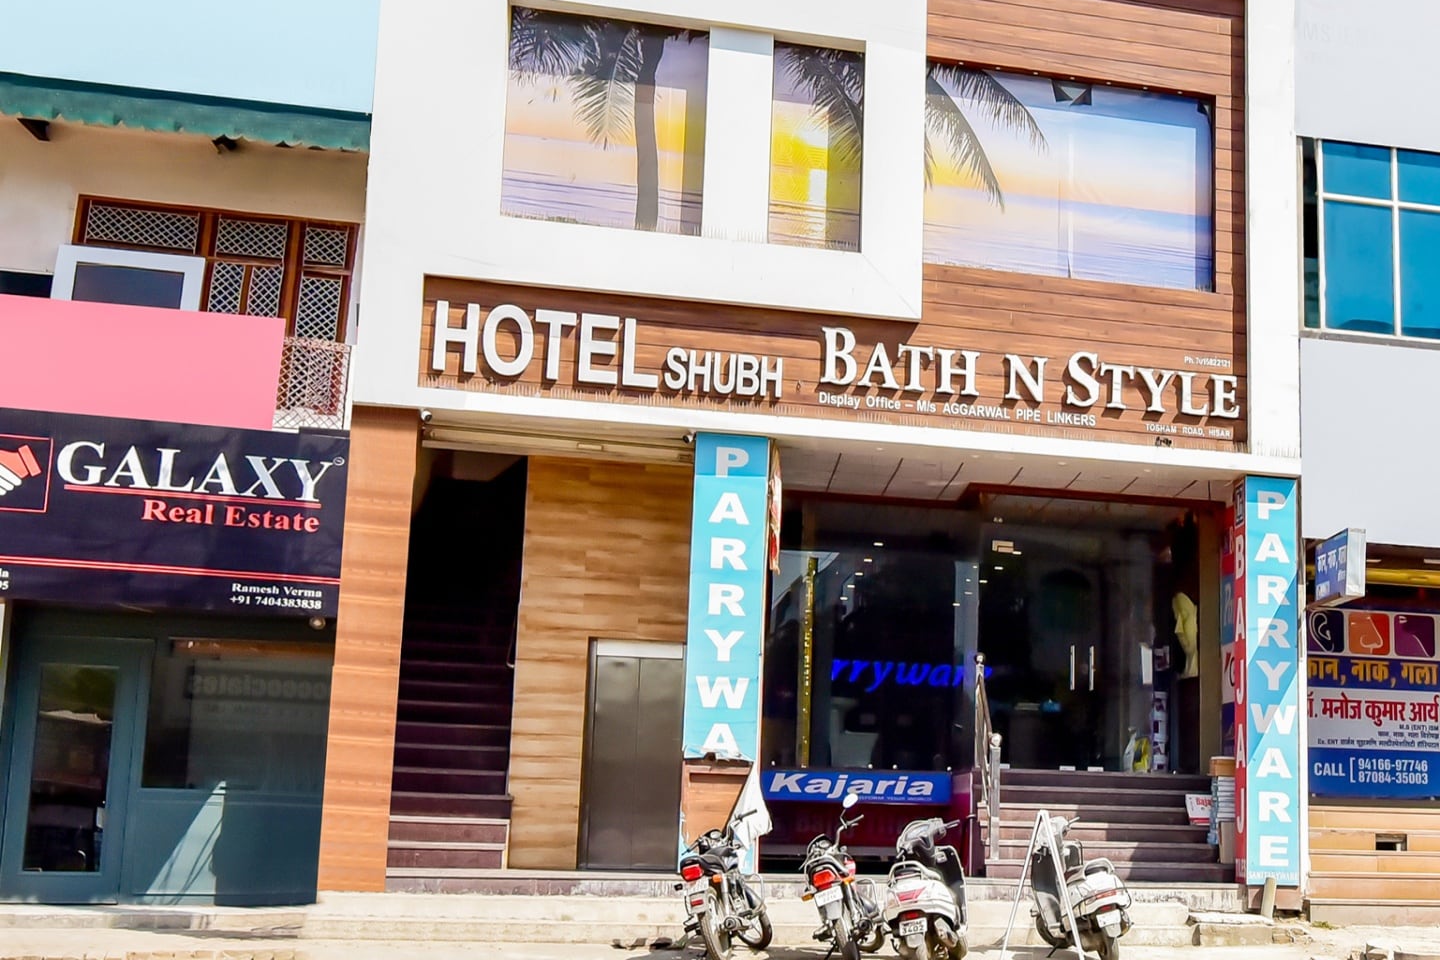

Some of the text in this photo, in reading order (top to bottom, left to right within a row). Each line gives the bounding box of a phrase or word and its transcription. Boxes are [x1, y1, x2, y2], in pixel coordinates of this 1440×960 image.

[432, 300, 783, 398] HOTEL SHUBH
[820, 326, 1240, 418] BATH N STYLE
[819, 392, 860, 409] Display
[866, 397, 901, 411] Office
[916, 401, 936, 413] M/s
[942, 402, 1010, 419] AGGARWAL
[1016, 408, 1040, 421] PIPE
[1047, 410, 1096, 426] LINKERS
[1146, 424, 1177, 433] TOSHAM
[57, 441, 334, 502] GALAXY
[141, 499, 321, 533] Real Estate
[230, 595, 250, 604] +91
[232, 583, 322, 597] Ramesh Verma
[1235, 534, 1246, 833] BAJAJ
[1250, 491, 1296, 867] PARRYWARE
[1401, 663, 1438, 685] गला
[1321, 692, 1362, 720] मनोज
[1365, 700, 1406, 727] कुमार
[1409, 695, 1440, 722] आर्य
[1314, 758, 1428, 776] CALL 94166-97746
[1358, 772, 1428, 784] 87084-35003
[769, 772, 934, 799] Kajaria
